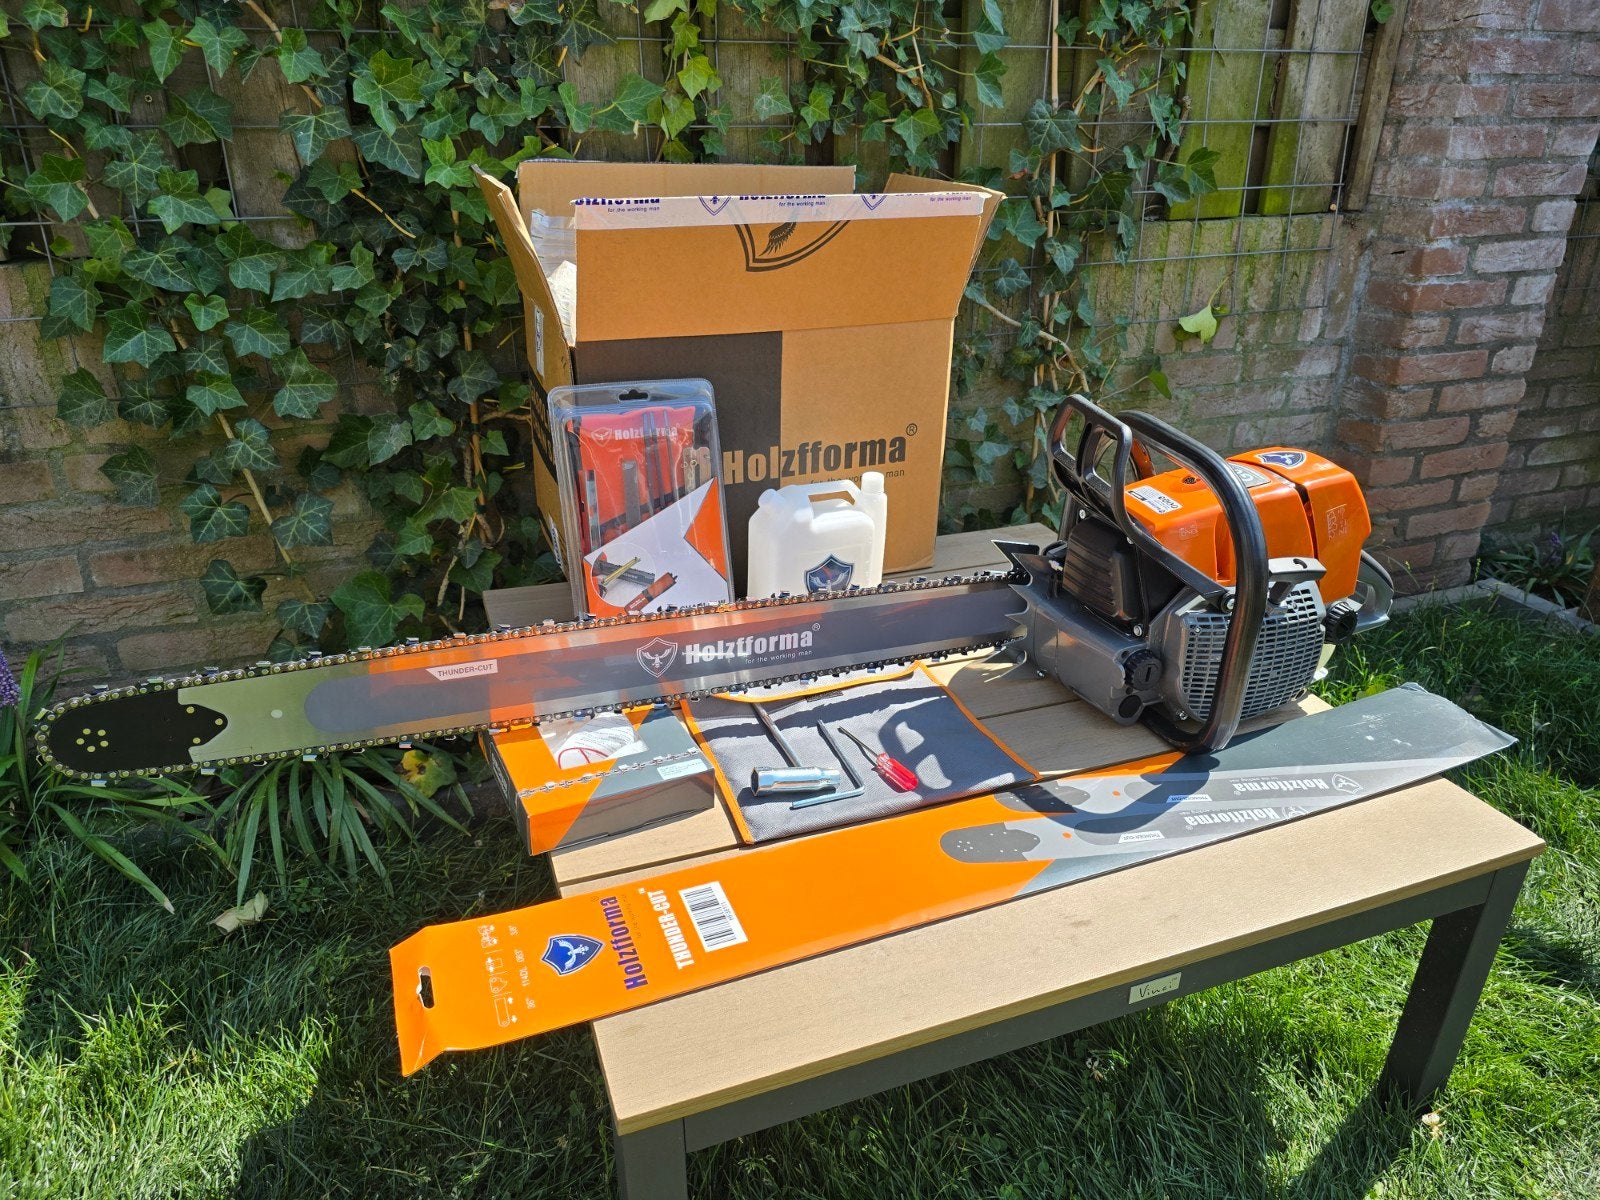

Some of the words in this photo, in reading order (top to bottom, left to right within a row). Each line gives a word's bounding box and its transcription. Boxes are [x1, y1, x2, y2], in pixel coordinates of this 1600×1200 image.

[885, 469, 905, 478] man
[770, 652, 796, 661] working
[437, 663, 493, 677] THUNDER-CUT
[646, 889, 695, 970] THUNDER-CUT
[1139, 981, 1172, 998] Vinci
